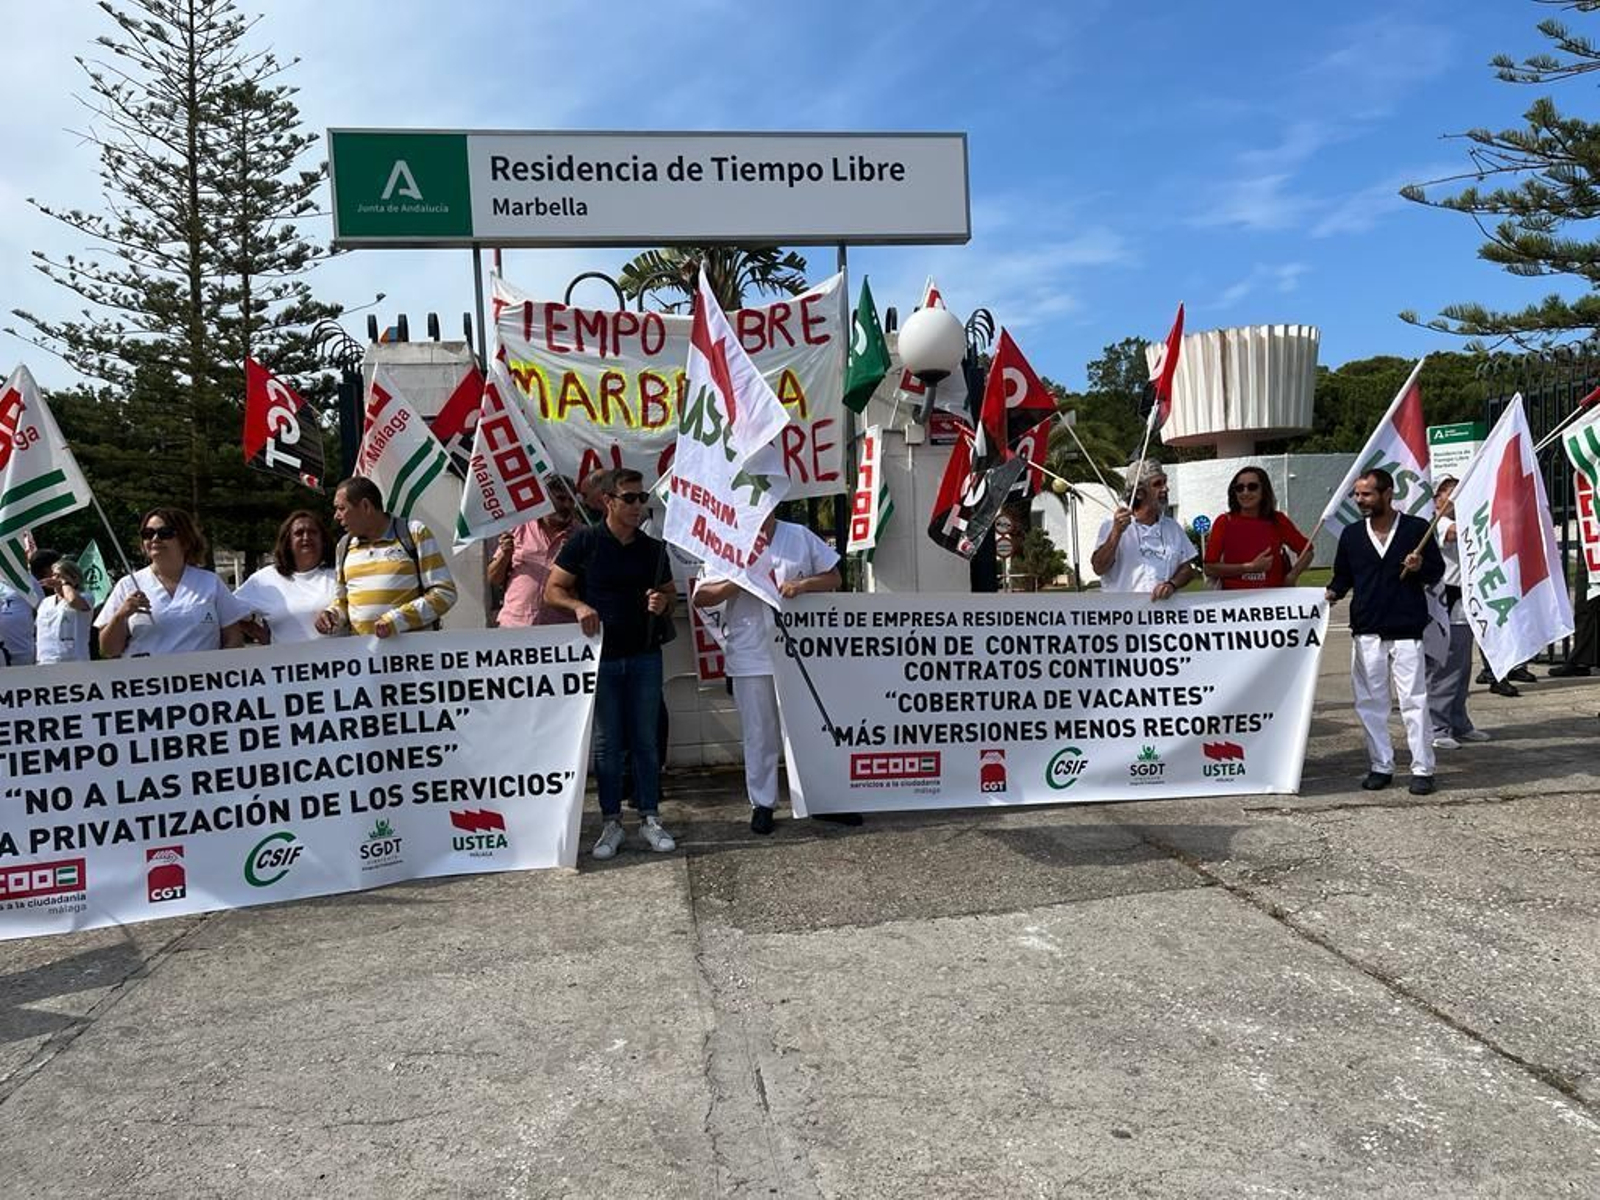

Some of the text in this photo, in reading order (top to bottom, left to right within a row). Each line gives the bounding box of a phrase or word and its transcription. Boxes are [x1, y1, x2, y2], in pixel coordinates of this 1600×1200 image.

[490, 154, 905, 188] Residencia de Tiempo Libre
[357, 203, 385, 214] Junta
[387, 203, 399, 213] de
[493, 197, 588, 217] Marbella
[492, 297, 666, 359] TIEMPO
[367, 408, 411, 462] Málaga
[470, 453, 506, 521] Málaga
[774, 604, 1321, 628] COMITÉ DE EMPRESA RESIDENCIA TIEMPO LIBRE DE MARBELLA
[774, 628, 1321, 658] “CONVERSIÓN DE CONTRATOS DISCONTINUOS A
[111, 668, 266, 699] RESIDENCIA
[271, 658, 361, 684] TIEMPO
[369, 653, 434, 675] LIBRE
[441, 650, 469, 670] DE
[476, 644, 595, 668] MARBELLA
[904, 657, 1191, 681] CONTRATOS CONTINUOS”
[92, 697, 276, 737] TEMPORAL
[284, 691, 325, 717] DE
[334, 686, 373, 713] LA
[381, 674, 555, 707] RESIDENCIA
[563, 671, 596, 695] DE
[885, 685, 1214, 713] “COBERTURA DE VACANTES”
[130, 731, 229, 764] LIBRE
[239, 725, 281, 752] DE
[291, 708, 470, 746] MARBELLA”
[894, 721, 1048, 746] INVERSIONES
[1055, 718, 1136, 740] MENOS
[1143, 712, 1274, 738] RECORTES”
[855, 757, 919, 775] CCOO
[1054, 760, 1089, 776] CSIF
[1130, 763, 1166, 776] SGDT
[1202, 763, 1246, 777] USTEA
[5, 744, 458, 815] “NO A LAS REUBICACIONES”
[982, 781, 1005, 791] CGT
[30, 793, 291, 854] PRIVATIZACIÓN
[301, 792, 341, 820] DE
[351, 784, 404, 813] LOS
[412, 770, 575, 804] SERVICIOS”
[359, 838, 402, 860] SGDT
[452, 833, 508, 851] USTEA
[256, 845, 304, 869] CSIF
[151, 886, 184, 901] CGT
